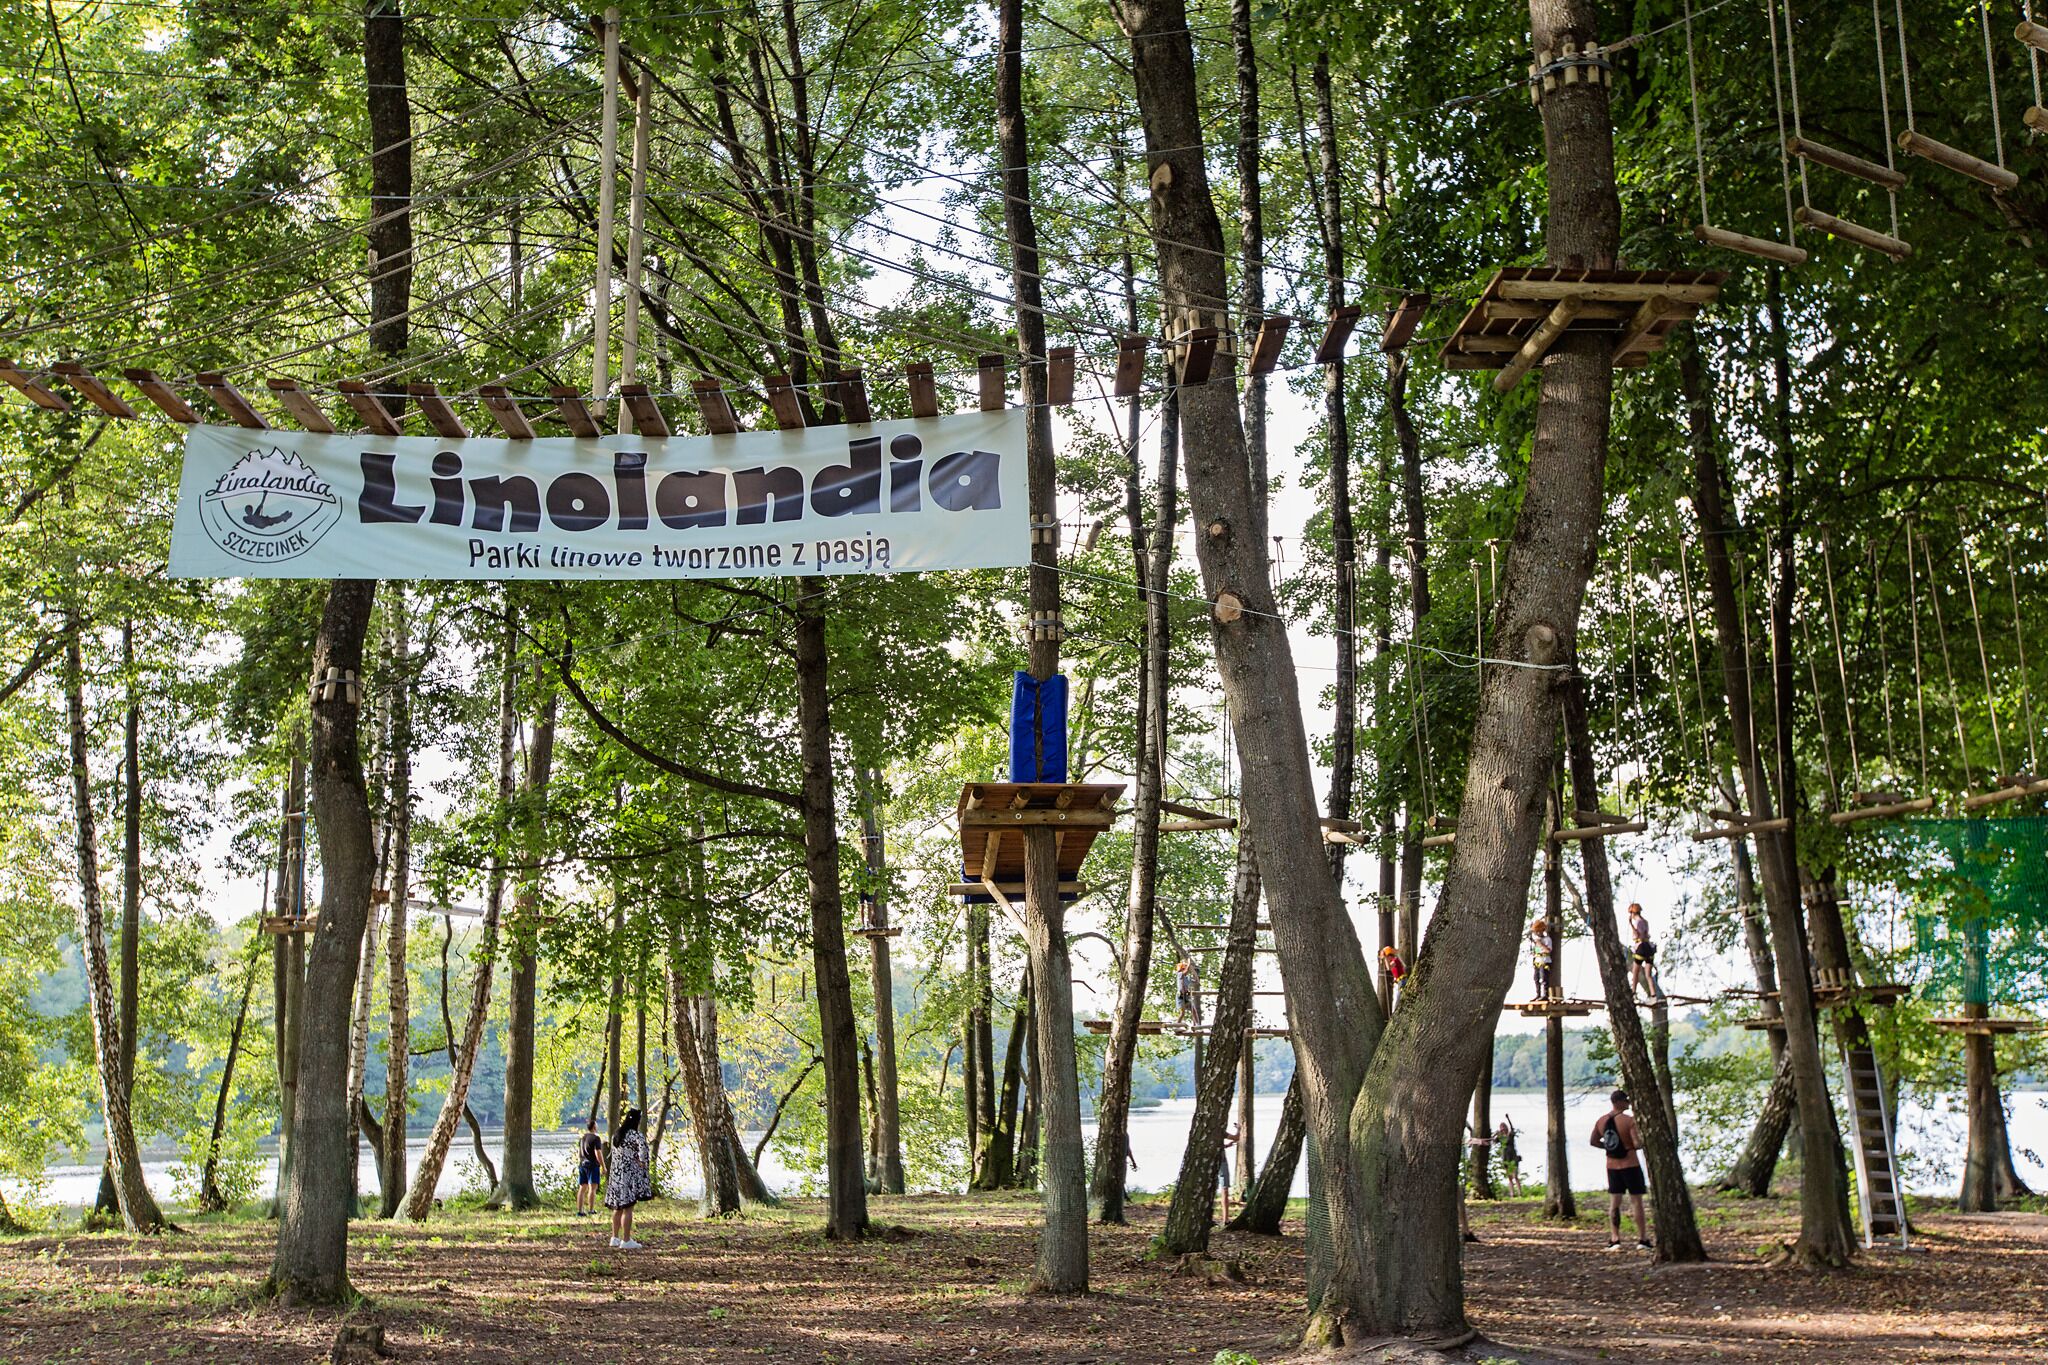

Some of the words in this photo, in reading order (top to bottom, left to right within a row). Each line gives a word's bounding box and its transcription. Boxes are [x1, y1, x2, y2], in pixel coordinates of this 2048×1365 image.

[359, 433, 1001, 533] Linolandia
[222, 530, 310, 558] SZCZECINEK
[469, 538, 540, 570] Parki
[551, 545, 642, 568] linowe
[652, 541, 782, 570] tworzone
[792, 542, 806, 567] z
[816, 531, 892, 571] pasją
